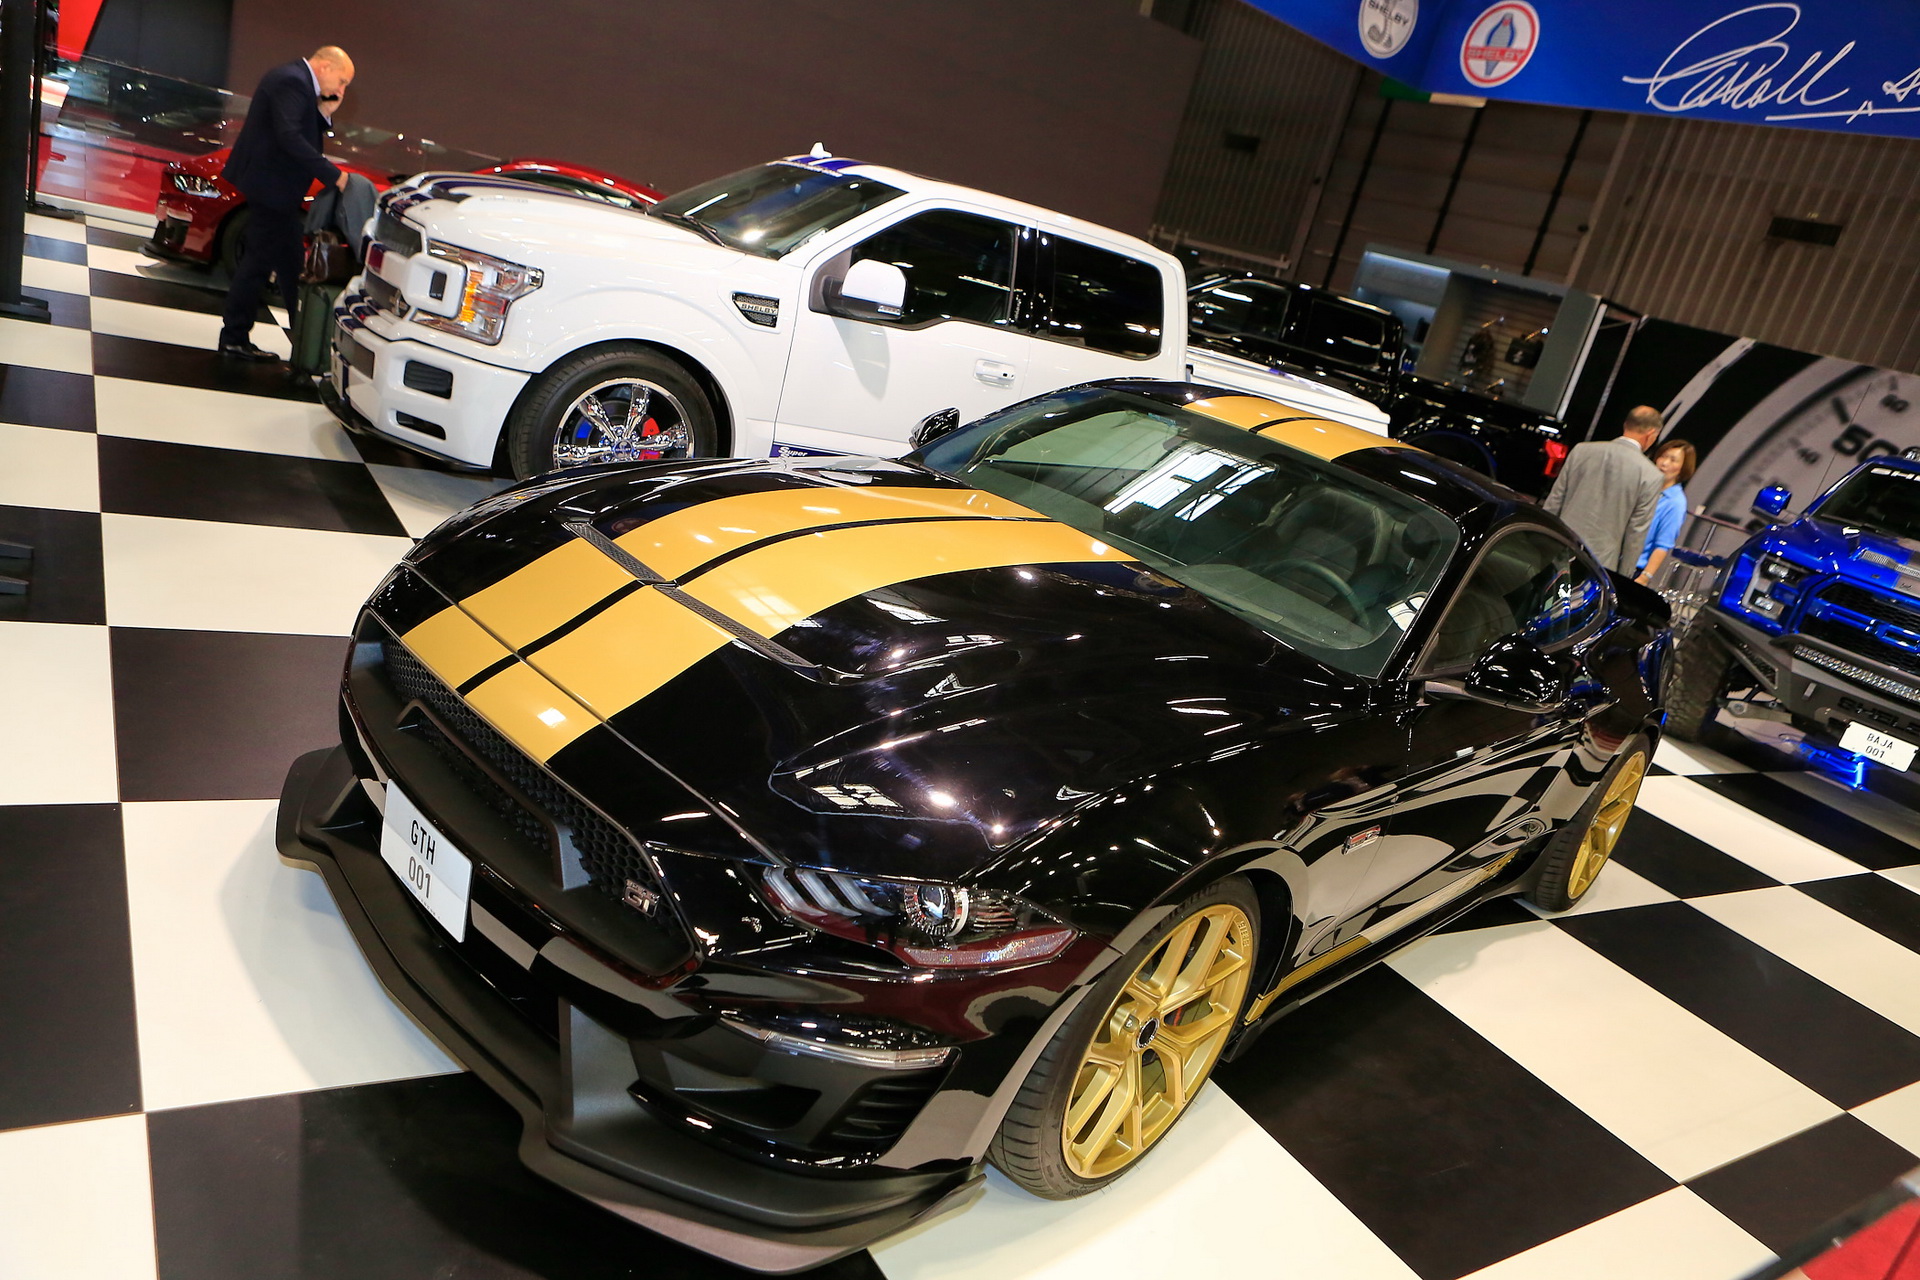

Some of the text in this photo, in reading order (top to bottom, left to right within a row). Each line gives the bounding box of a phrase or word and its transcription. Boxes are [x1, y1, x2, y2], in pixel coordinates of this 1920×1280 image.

[1467, 46, 1526, 63] SHELBY
[741, 303, 777, 314] SHELBY
[778, 446, 808, 457] Super
[1867, 732, 1893, 750] BAJA
[1865, 745, 1885, 759] 001
[410, 819, 436, 865] GTH
[408, 856, 431, 899] 001
[624, 886, 657, 913] GT
